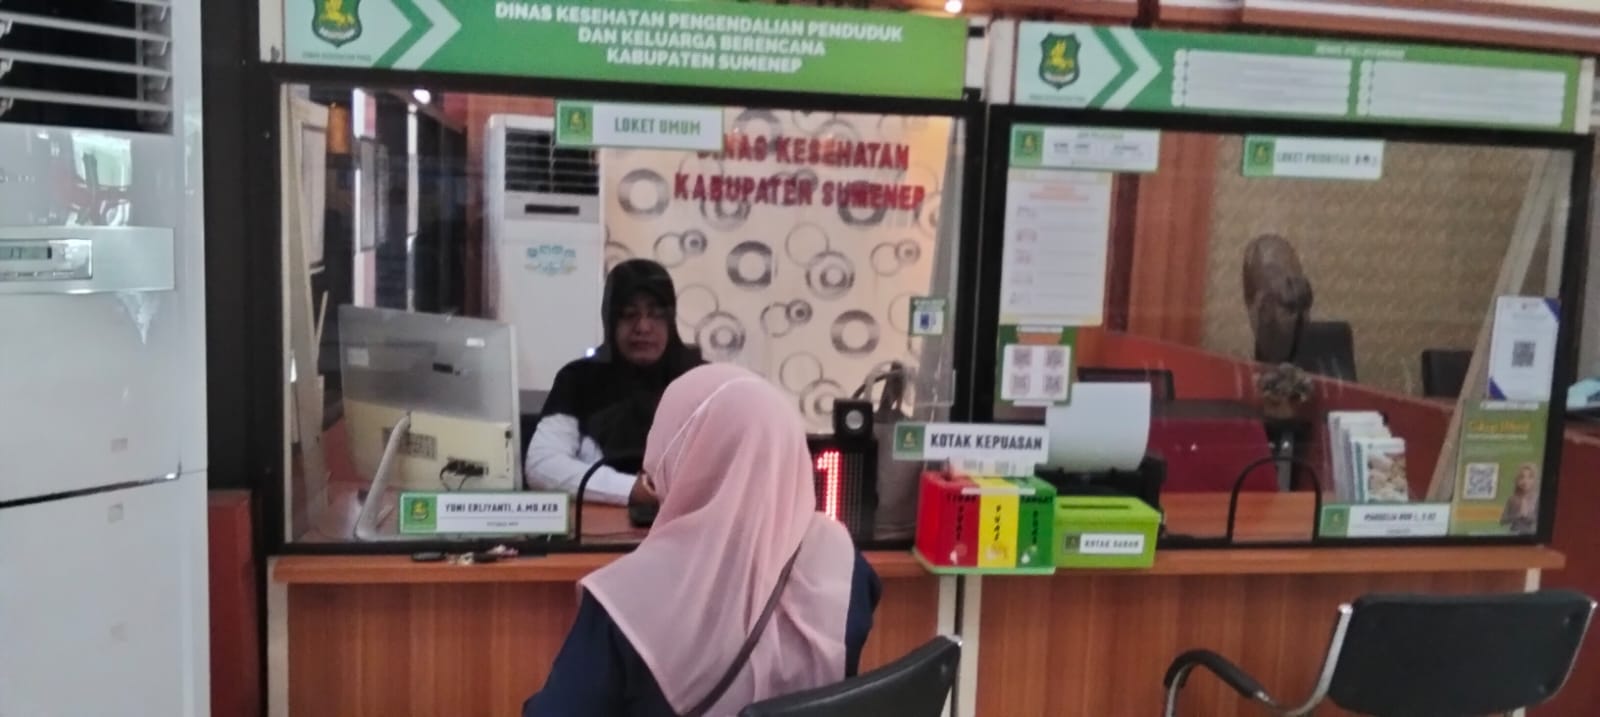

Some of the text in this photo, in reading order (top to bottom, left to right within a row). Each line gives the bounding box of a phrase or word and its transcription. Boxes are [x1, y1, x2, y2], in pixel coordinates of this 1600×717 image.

[495, 2, 903, 41] DINAS KESEHATAN PENGENDALIAN PENDUDUK
[578, 26, 826, 56] DAN KELUARGA BERENCANA
[606, 48, 803, 73] KABUPATEN SUMENEP
[614, 116, 702, 135] LOKET UMUM
[697, 132, 910, 171] NAS KESEHATAN
[674, 172, 926, 210] KABUPATEN SUMENEP
[930, 433, 1043, 450] KOTAK KEPUASAN
[816, 451, 840, 521] 1
